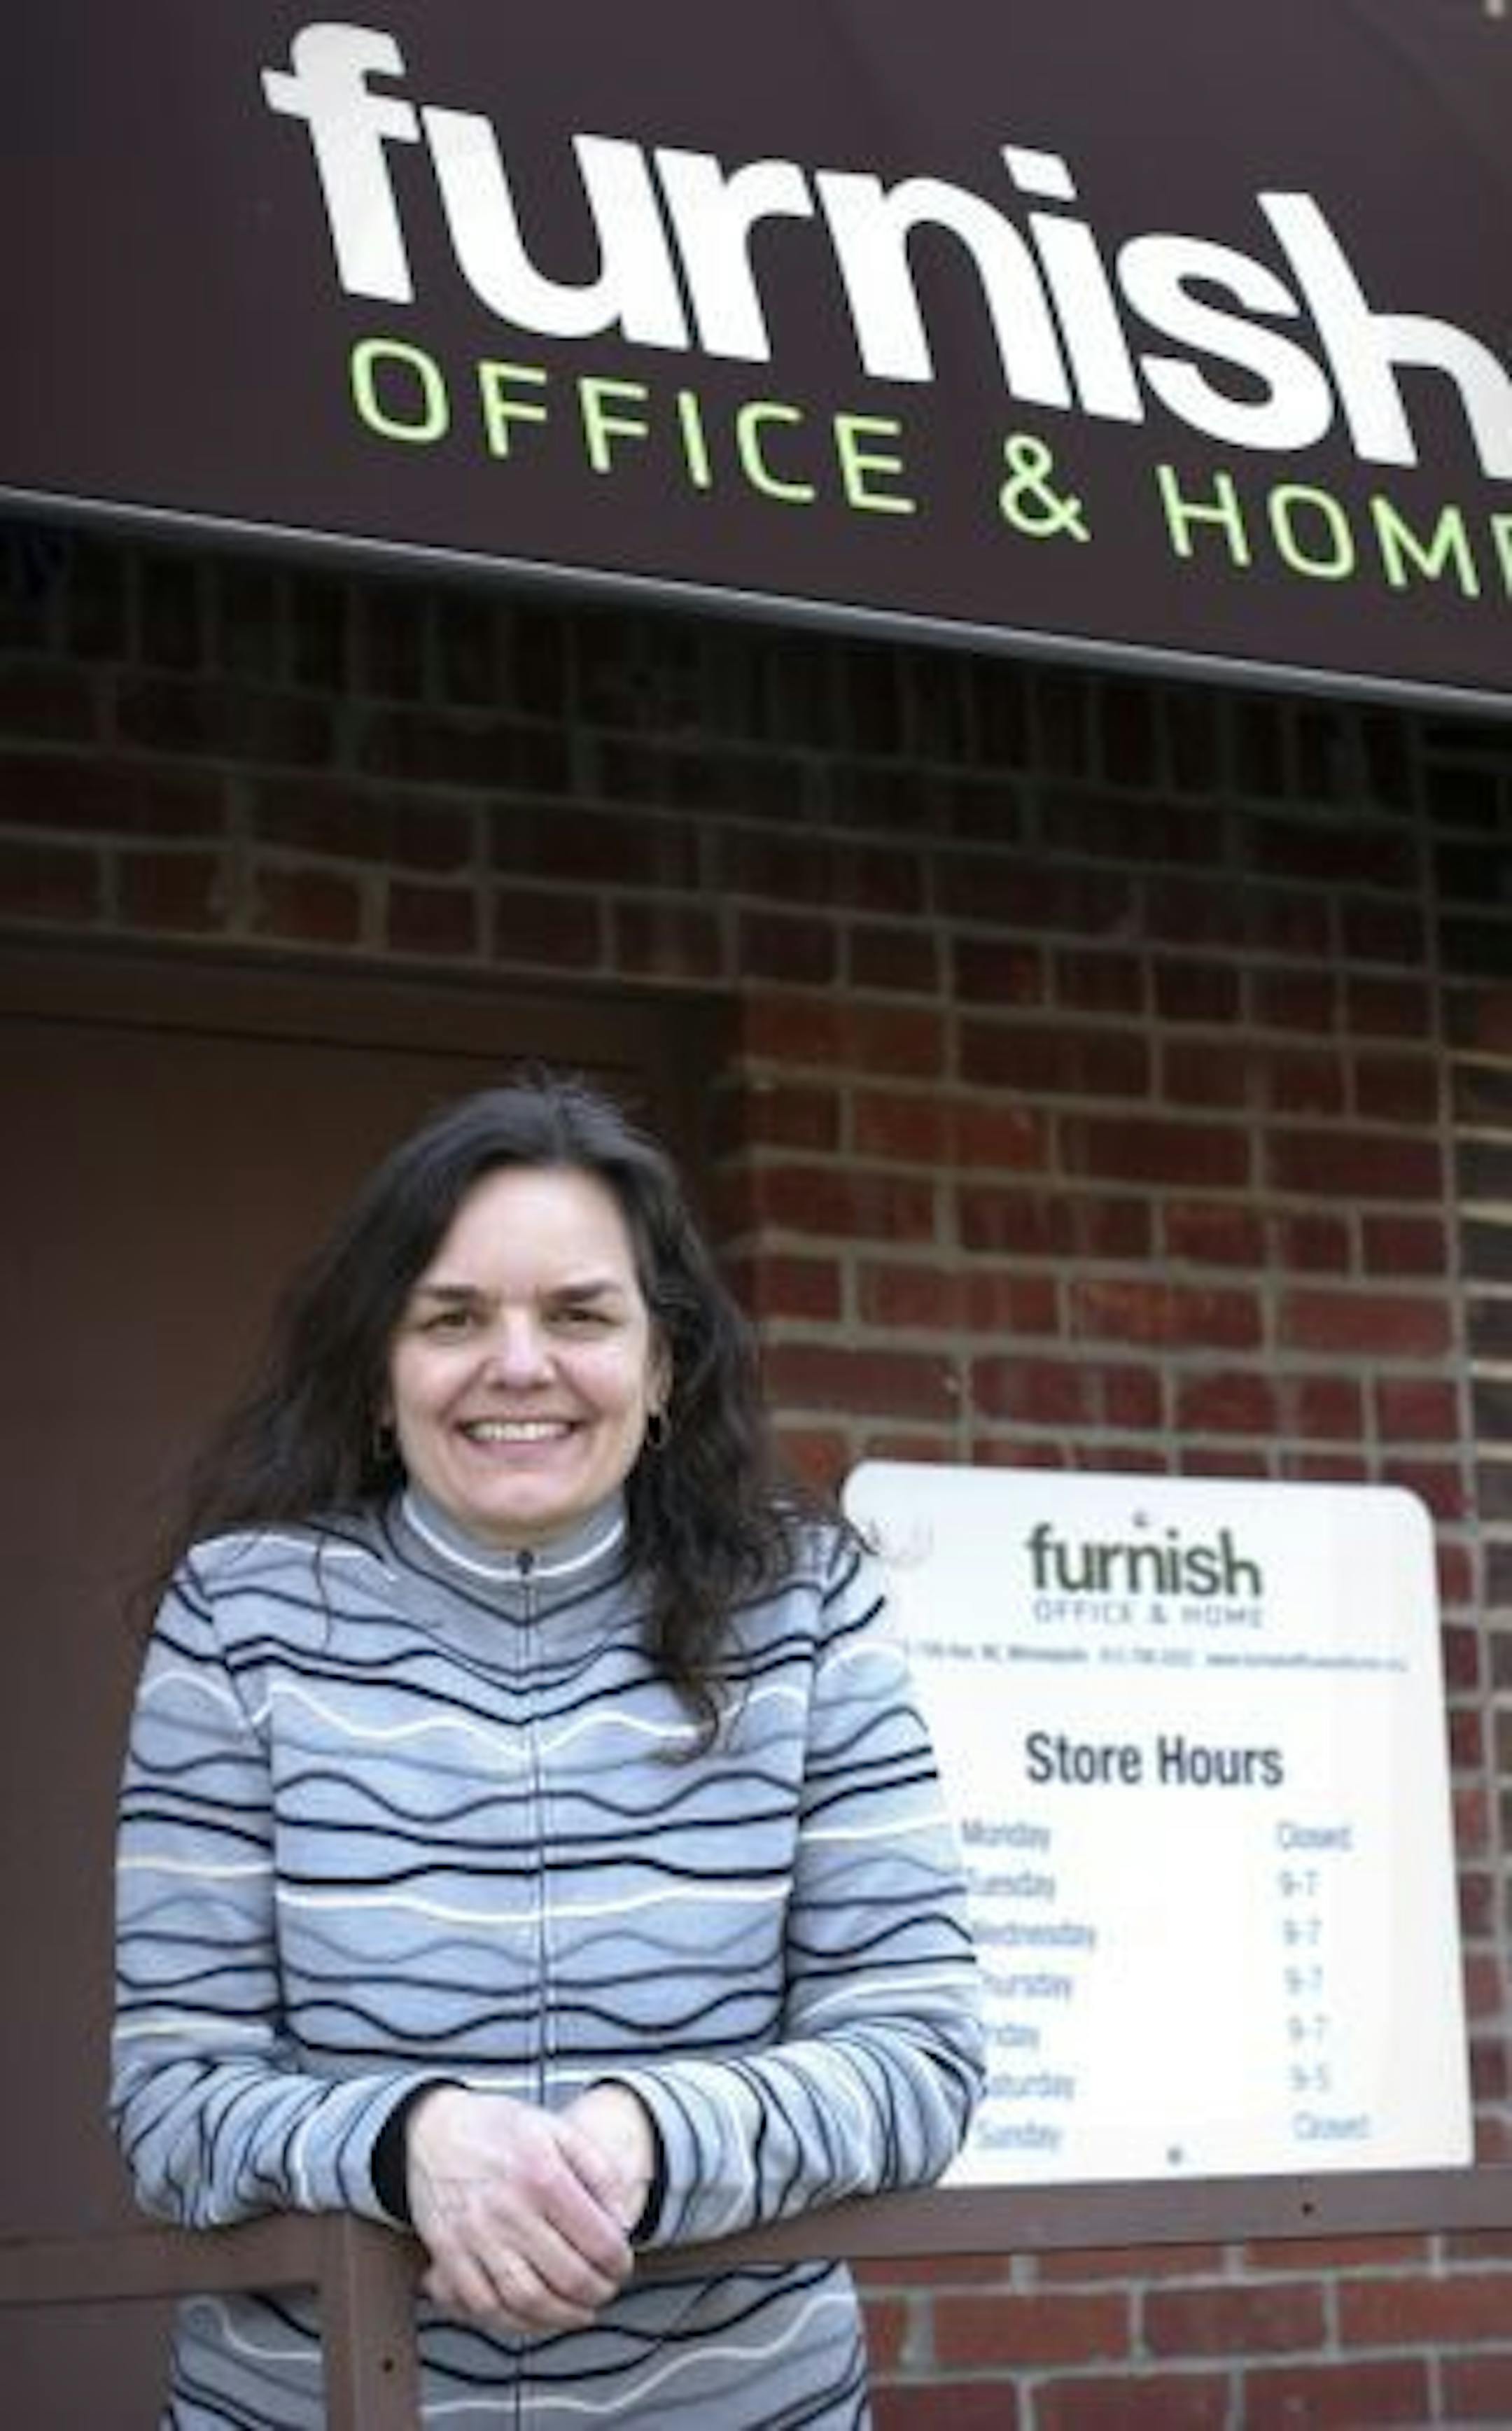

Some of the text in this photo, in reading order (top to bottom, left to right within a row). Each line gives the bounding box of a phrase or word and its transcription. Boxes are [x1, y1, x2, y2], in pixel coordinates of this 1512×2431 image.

[261, 22, 1512, 482] furnish
[351, 339, 1512, 602] OFFICE & HOM
[1025, 1520, 1262, 1597] furnish
[1032, 1598, 1130, 1625] OFFICE
[1181, 1603, 1261, 1630] HOME
[1026, 1730, 1284, 1786] Store Hours
[961, 1819, 1353, 1854] Monday Closed
[988, 2071, 1076, 2101] aturday
[975, 2109, 1371, 2152] Sunday Closed
